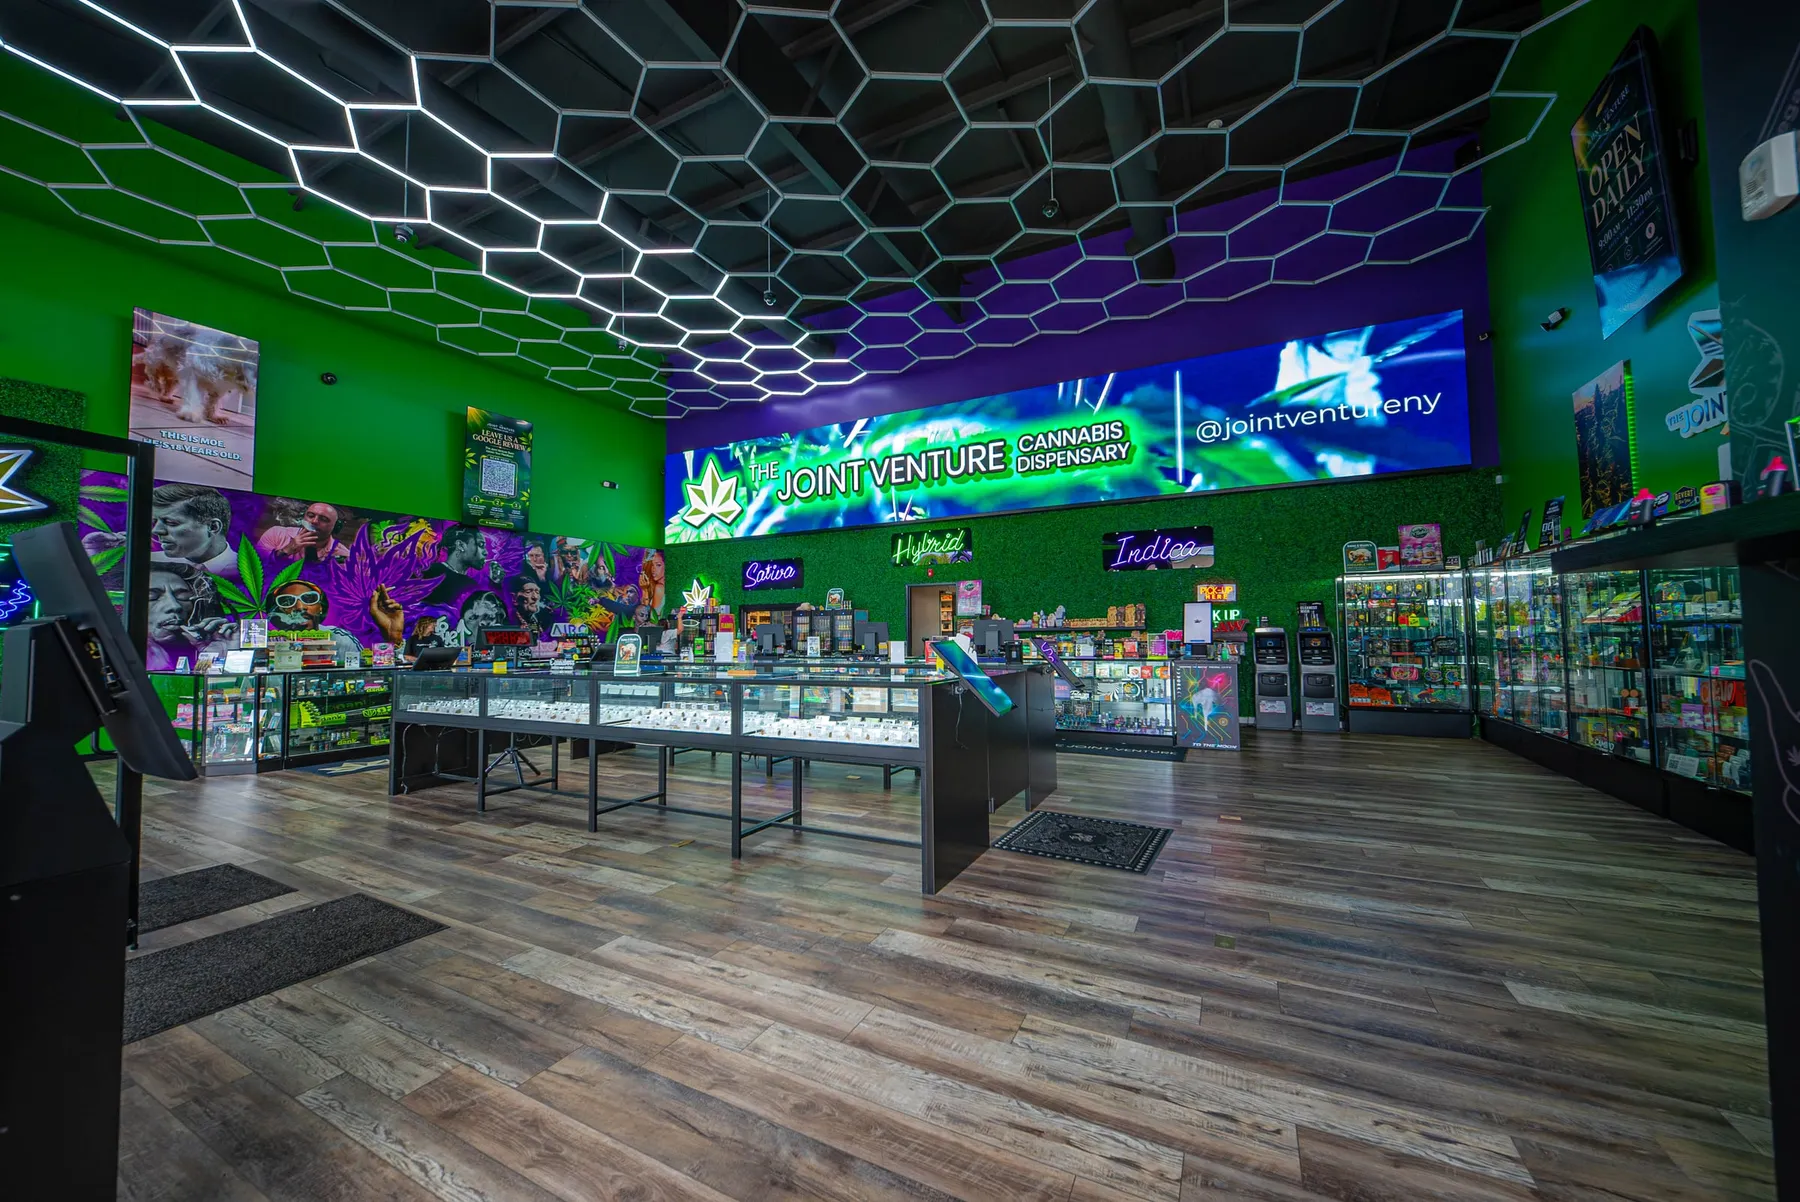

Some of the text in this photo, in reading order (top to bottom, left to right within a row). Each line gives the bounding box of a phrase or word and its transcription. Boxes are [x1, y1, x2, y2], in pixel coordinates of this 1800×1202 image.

[1589, 111, 1642, 197] OPEN
[1592, 142, 1646, 228] DAILY
[1196, 392, 1442, 443] @jointventureny
[1668, 391, 1728, 434] THE JOIN
[160, 430, 226, 448] THIS IS MOE.
[472, 433, 527, 452] GOOGLE REVIEW
[481, 429, 503, 441] LEAVE
[504, 434, 513, 442] US
[1018, 421, 1123, 452] CANNABIS
[170, 443, 182, 452] 18
[183, 445, 218, 457] YEARS
[219, 451, 242, 461] OLD.
[1017, 442, 1131, 472] DISPENSARY
[749, 441, 1005, 501] THE JOINT VENTURE
[893, 529, 965, 563] Hybrid
[1110, 535, 1201, 567] Indica
[744, 562, 795, 588] Sativa
[1213, 619, 1250, 633] AW
[1066, 743, 1112, 751] JOINT
[1114, 746, 1177, 755] VENTURE
